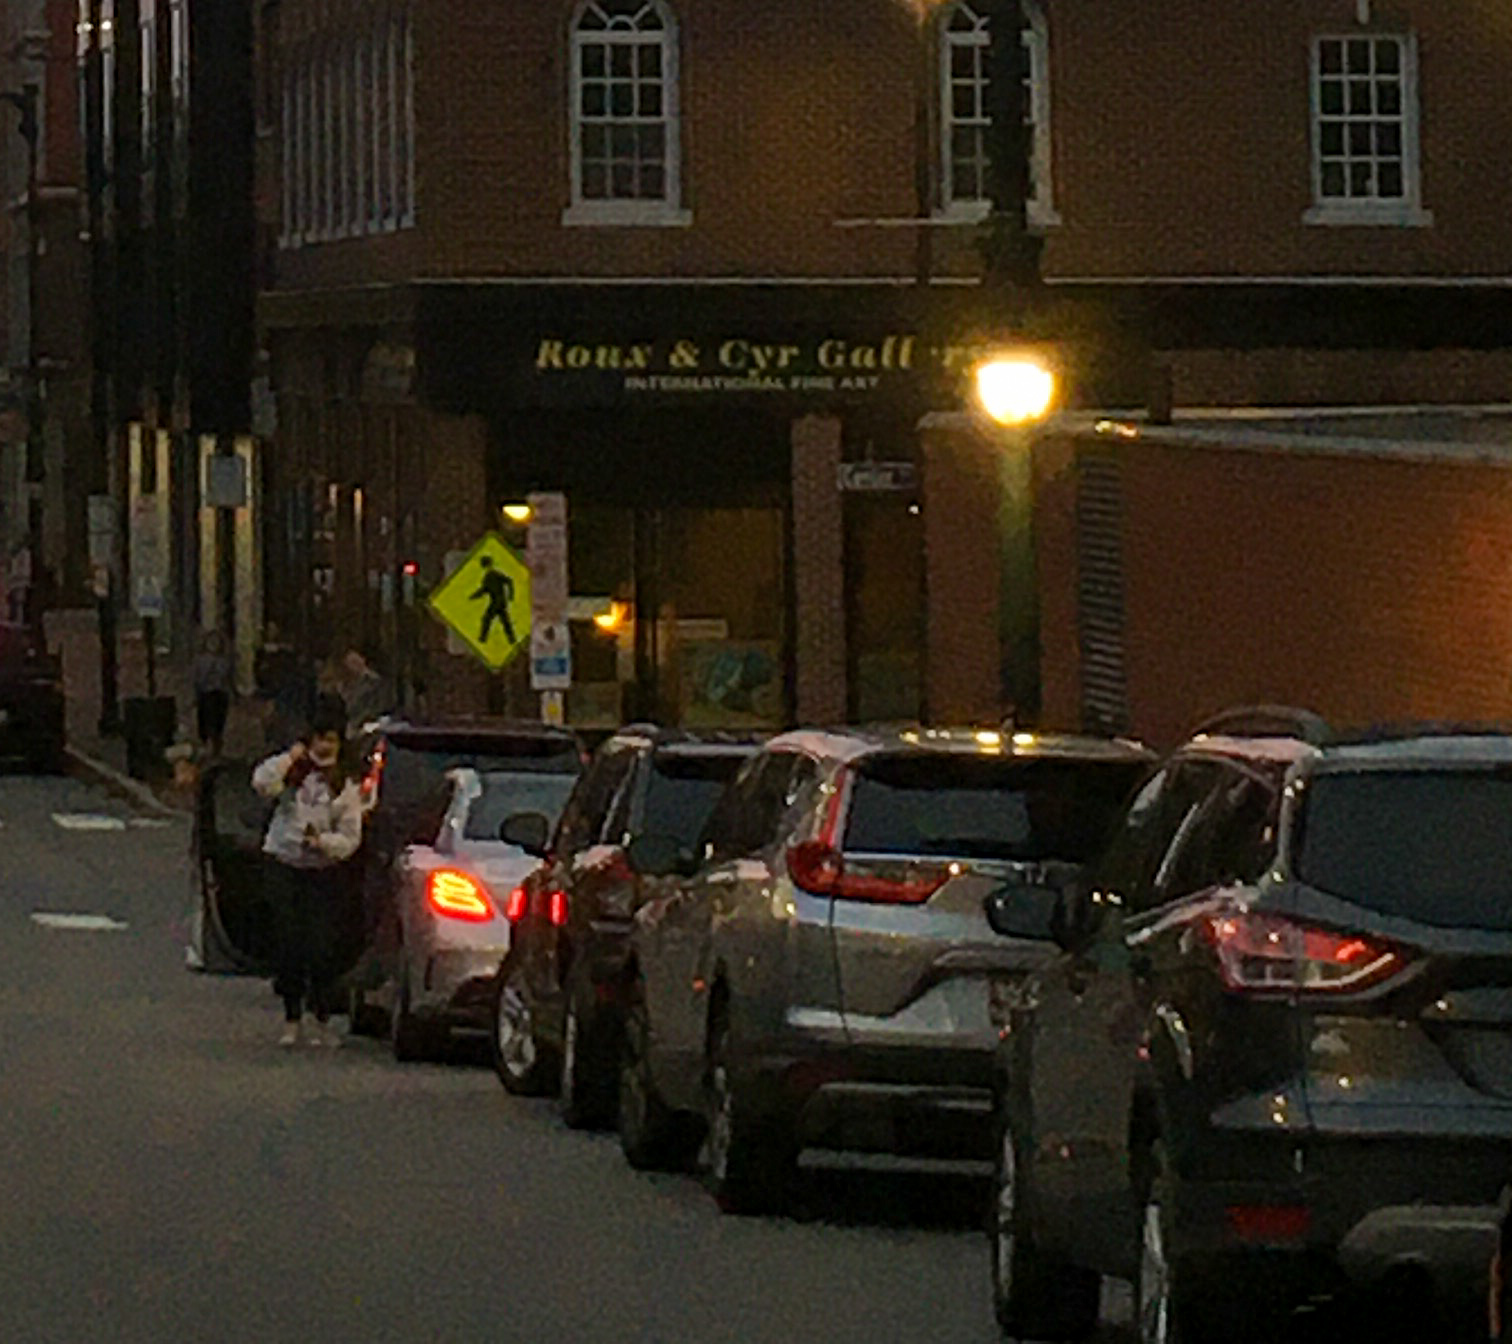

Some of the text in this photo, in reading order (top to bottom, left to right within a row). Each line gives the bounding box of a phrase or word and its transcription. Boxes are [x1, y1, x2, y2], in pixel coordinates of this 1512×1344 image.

[537, 339, 654, 369] Roux
[668, 339, 701, 368] &
[719, 339, 800, 380] Cyr
